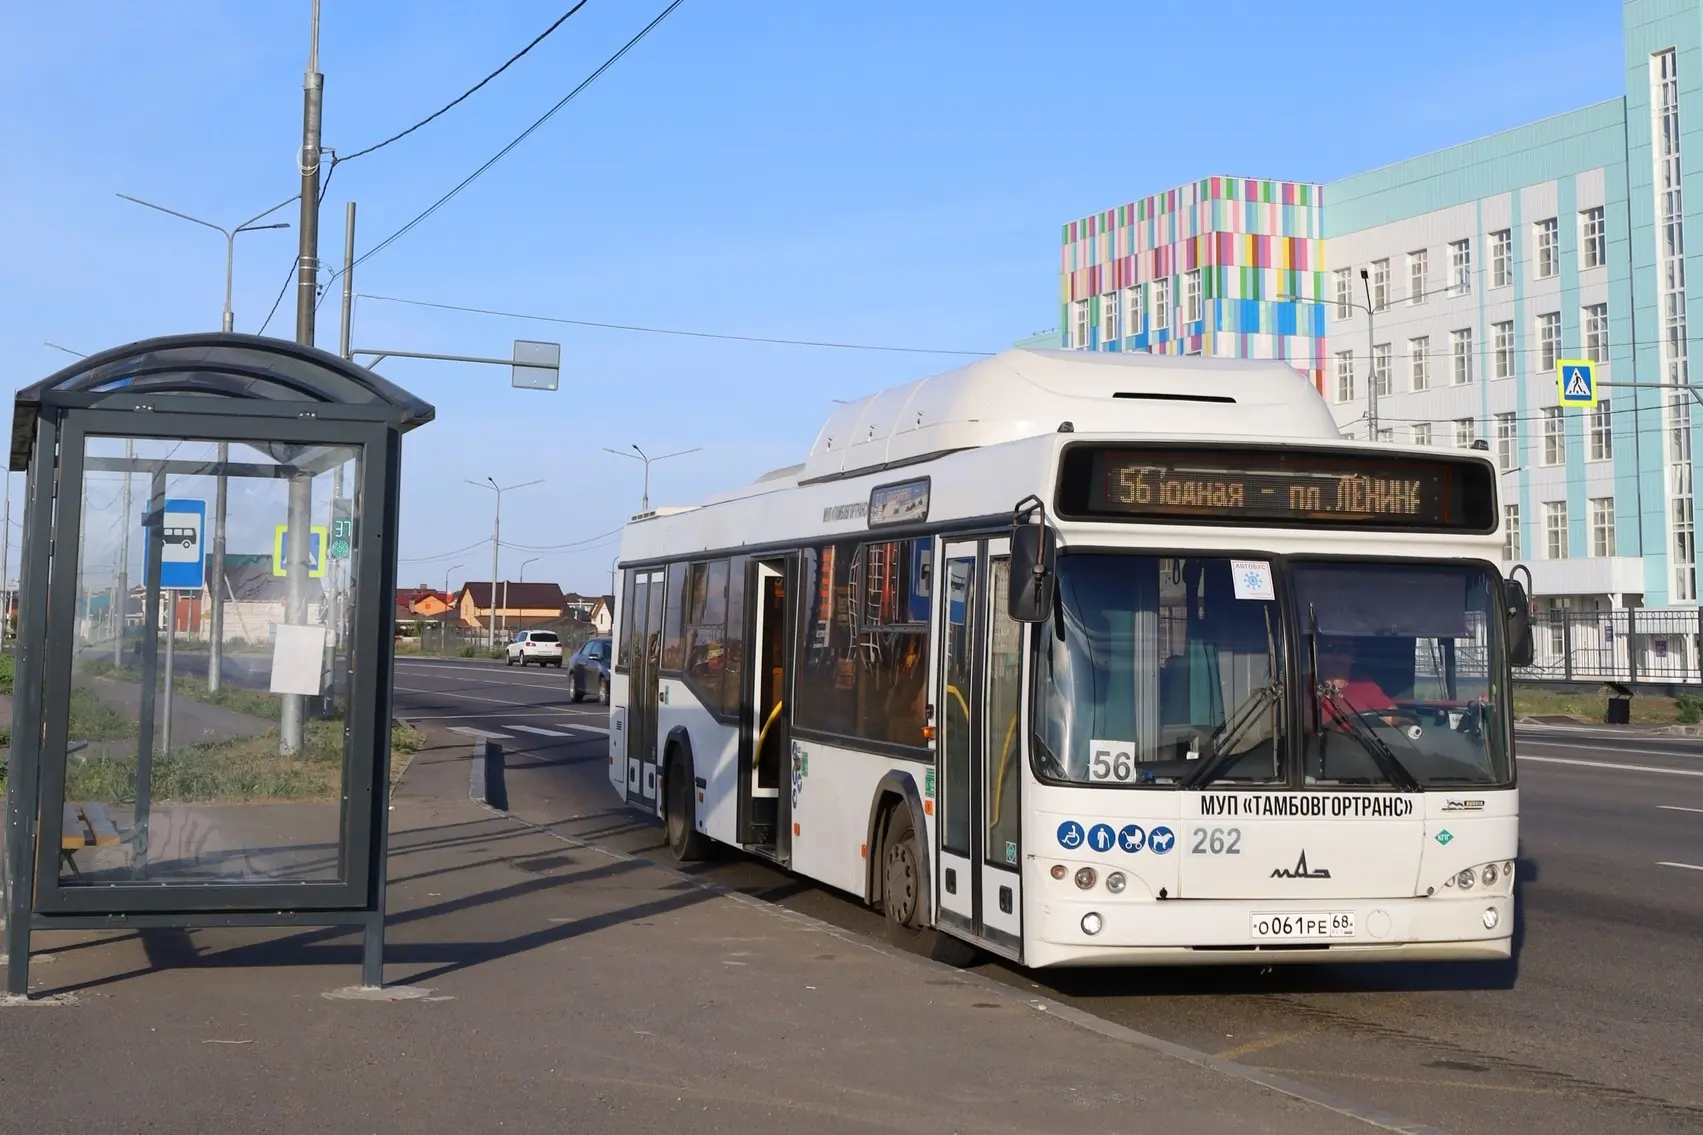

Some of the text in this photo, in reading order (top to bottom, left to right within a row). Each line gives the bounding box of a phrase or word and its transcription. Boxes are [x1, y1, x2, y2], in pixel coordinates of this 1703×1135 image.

[1120, 468, 1151, 503] 56
[335, 520, 351, 537] 37
[1092, 750, 1131, 781] 56
[1200, 795, 1413, 817] МУП «ТАМБОВГОРТРАНС»
[1191, 827, 1242, 855] 262
[1258, 914, 1349, 935] О061РЕ 68
